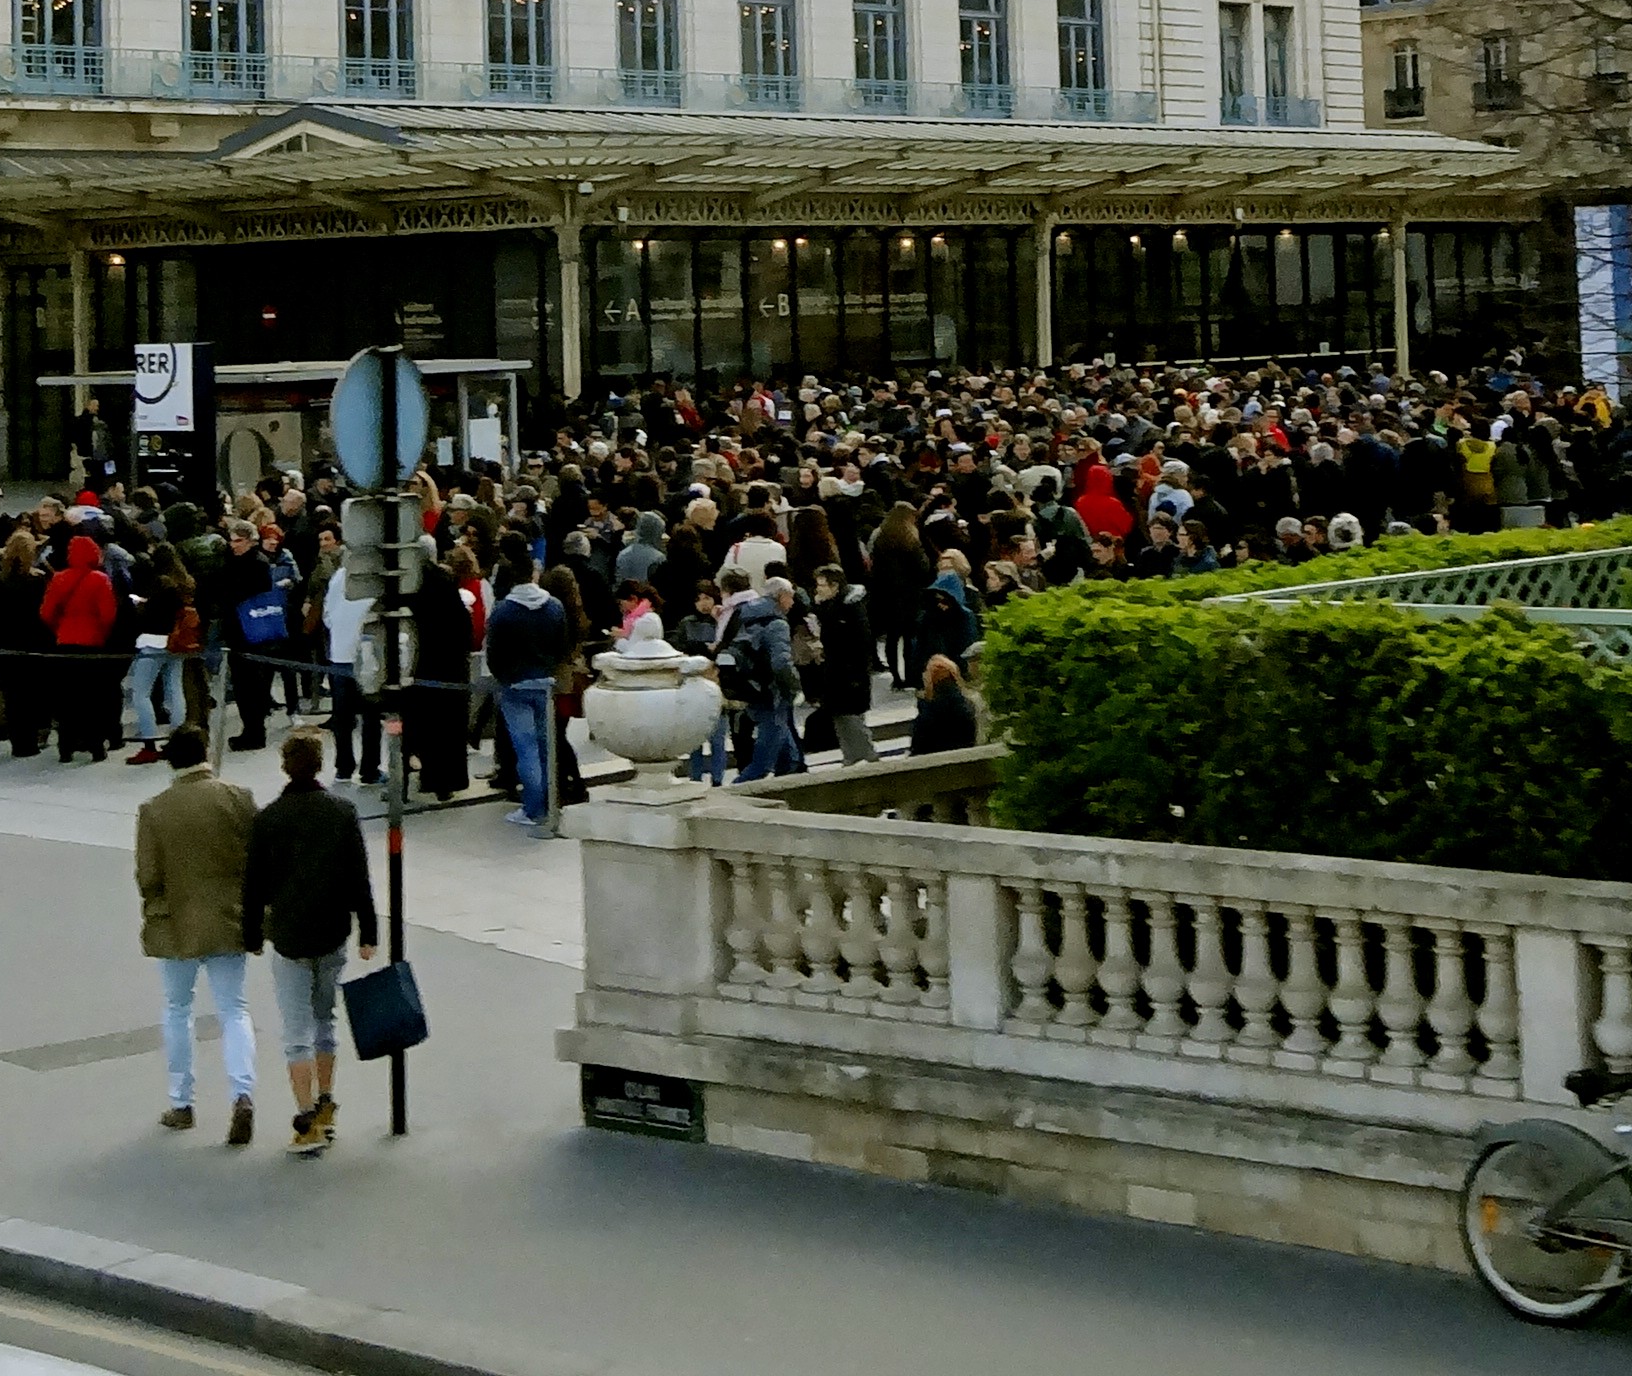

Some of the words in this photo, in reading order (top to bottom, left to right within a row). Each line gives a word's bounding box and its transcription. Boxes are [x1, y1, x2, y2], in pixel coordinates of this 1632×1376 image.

[625, 298, 642, 322] A
[778, 293, 790, 317] B
[135, 352, 170, 374] RER
